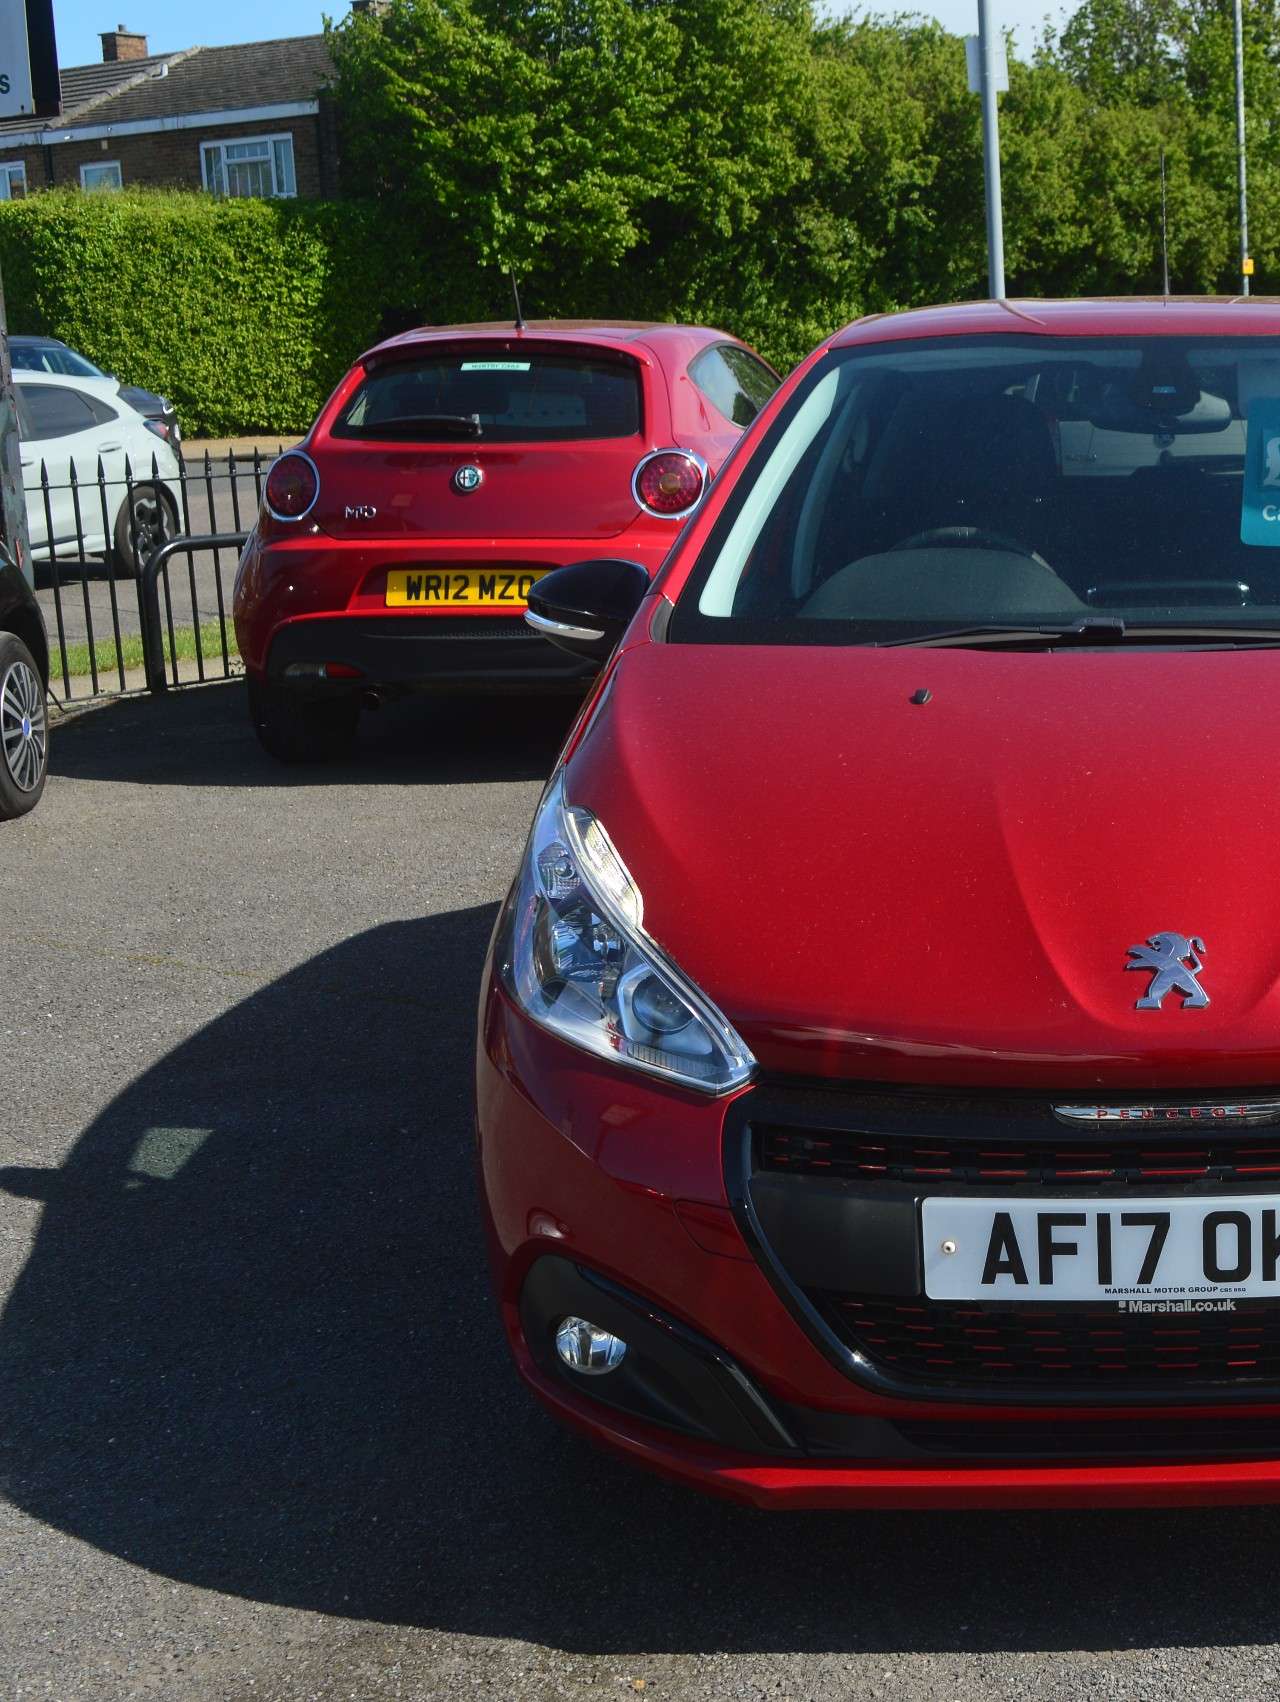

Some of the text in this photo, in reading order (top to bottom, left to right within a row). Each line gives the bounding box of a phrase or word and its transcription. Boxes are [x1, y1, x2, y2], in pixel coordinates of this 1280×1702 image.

[406, 575, 470, 601] WR12
[1096, 1106, 1247, 1119] PEUGEOT
[981, 1212, 1171, 1285] AF17
[1154, 1286, 1186, 1294] MOTOR
[1128, 1299, 1237, 1313] Marshall.co.uk
